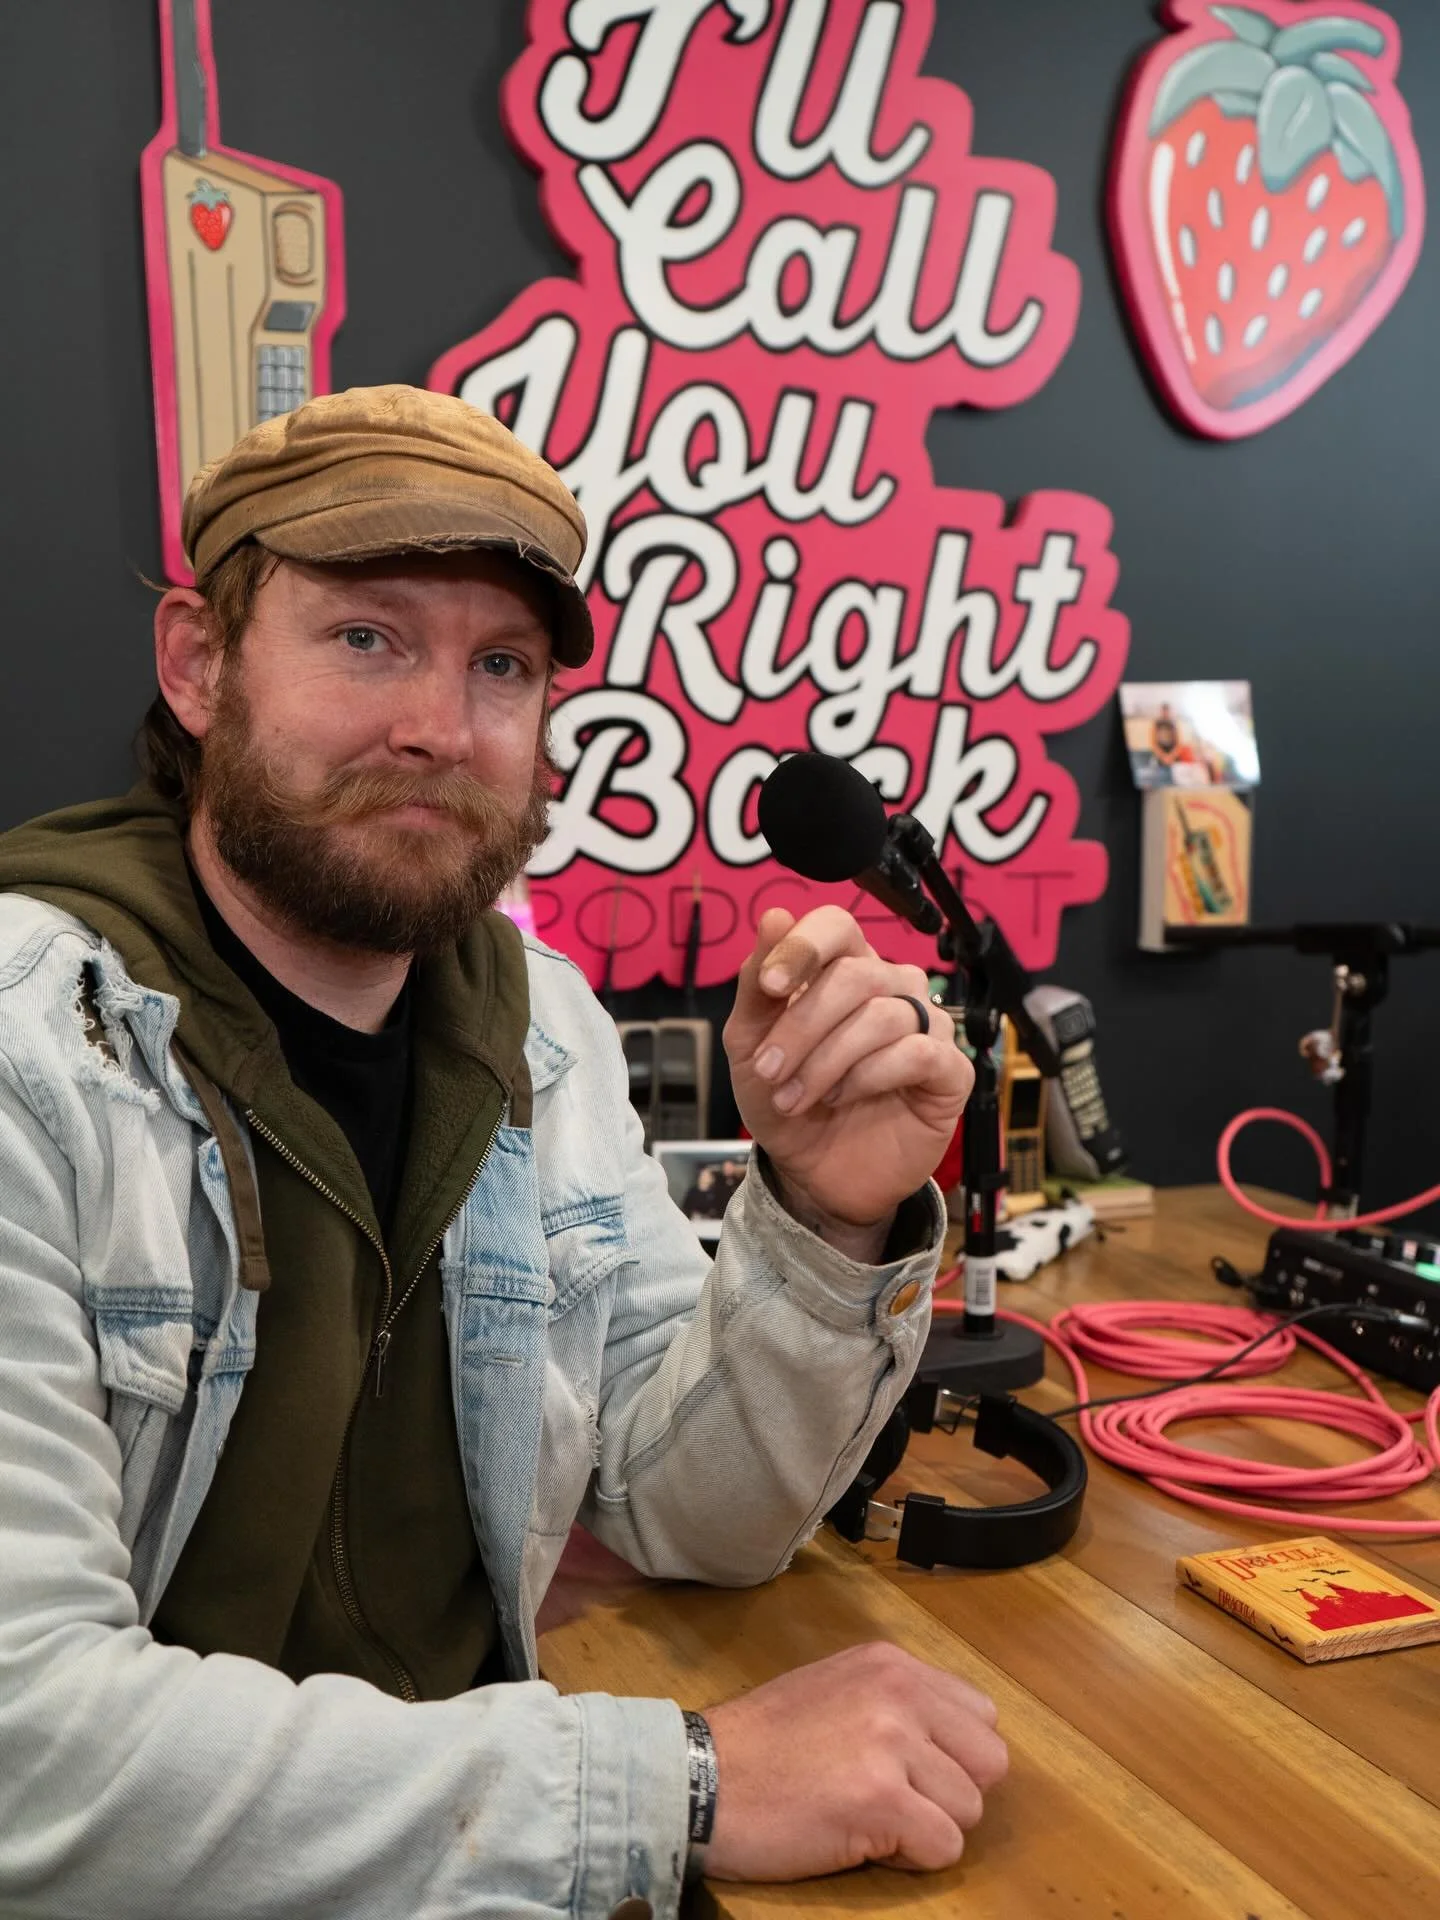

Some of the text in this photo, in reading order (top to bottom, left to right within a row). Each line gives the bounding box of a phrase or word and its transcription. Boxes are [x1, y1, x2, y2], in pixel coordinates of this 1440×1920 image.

[538, 0, 932, 189] I'll
[576, 138, 1043, 369] Call
[453, 311, 896, 597] You
[602, 514, 1097, 755] Right
[1213, 1547, 1336, 1581] DRACULA
[1217, 1587, 1256, 1625] DRACULA
